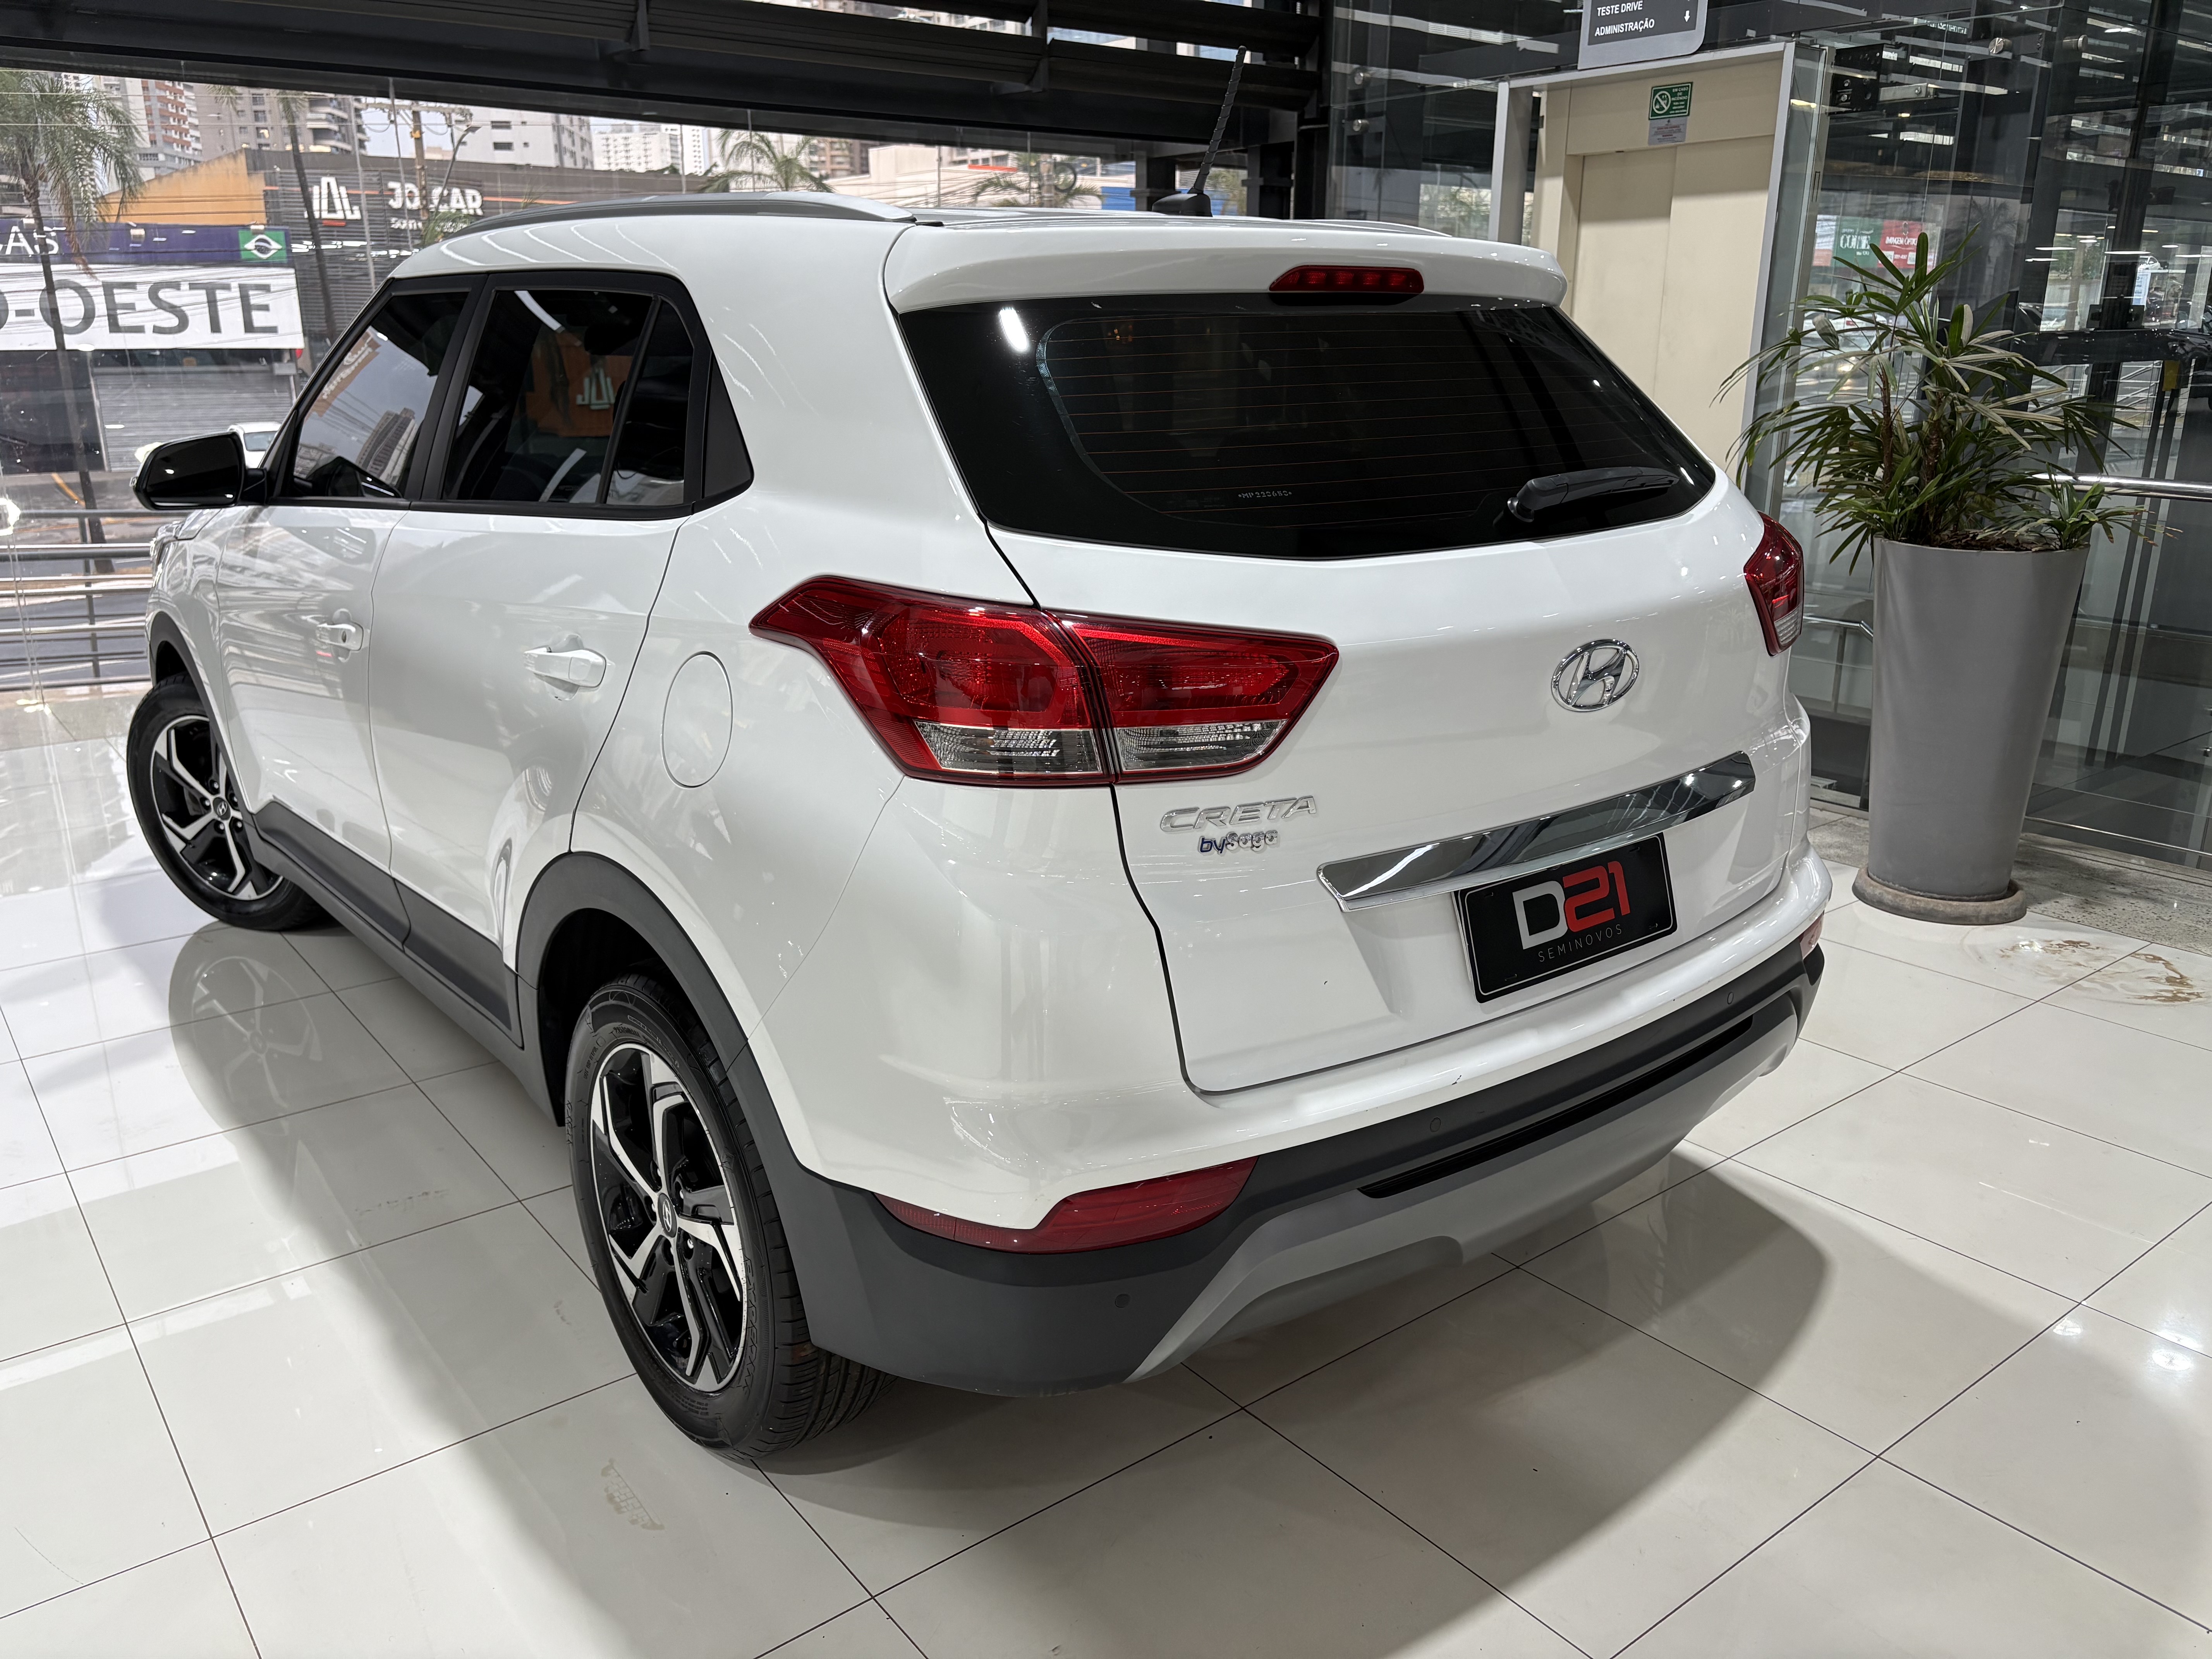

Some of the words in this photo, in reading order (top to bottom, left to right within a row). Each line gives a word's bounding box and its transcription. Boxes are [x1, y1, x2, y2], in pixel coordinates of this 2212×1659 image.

[1597, 3, 1620, 16] TESTE
[1621, 0, 1643, 13] DRIVE
[1594, 18, 1655, 36] ADMINISTRAÇÃO
[0, 279, 278, 335] -OESTE
[1160, 795, 1317, 832] CRETA
[1512, 860, 1630, 950] D21
[1538, 924, 1623, 962] SEMINOVOS
